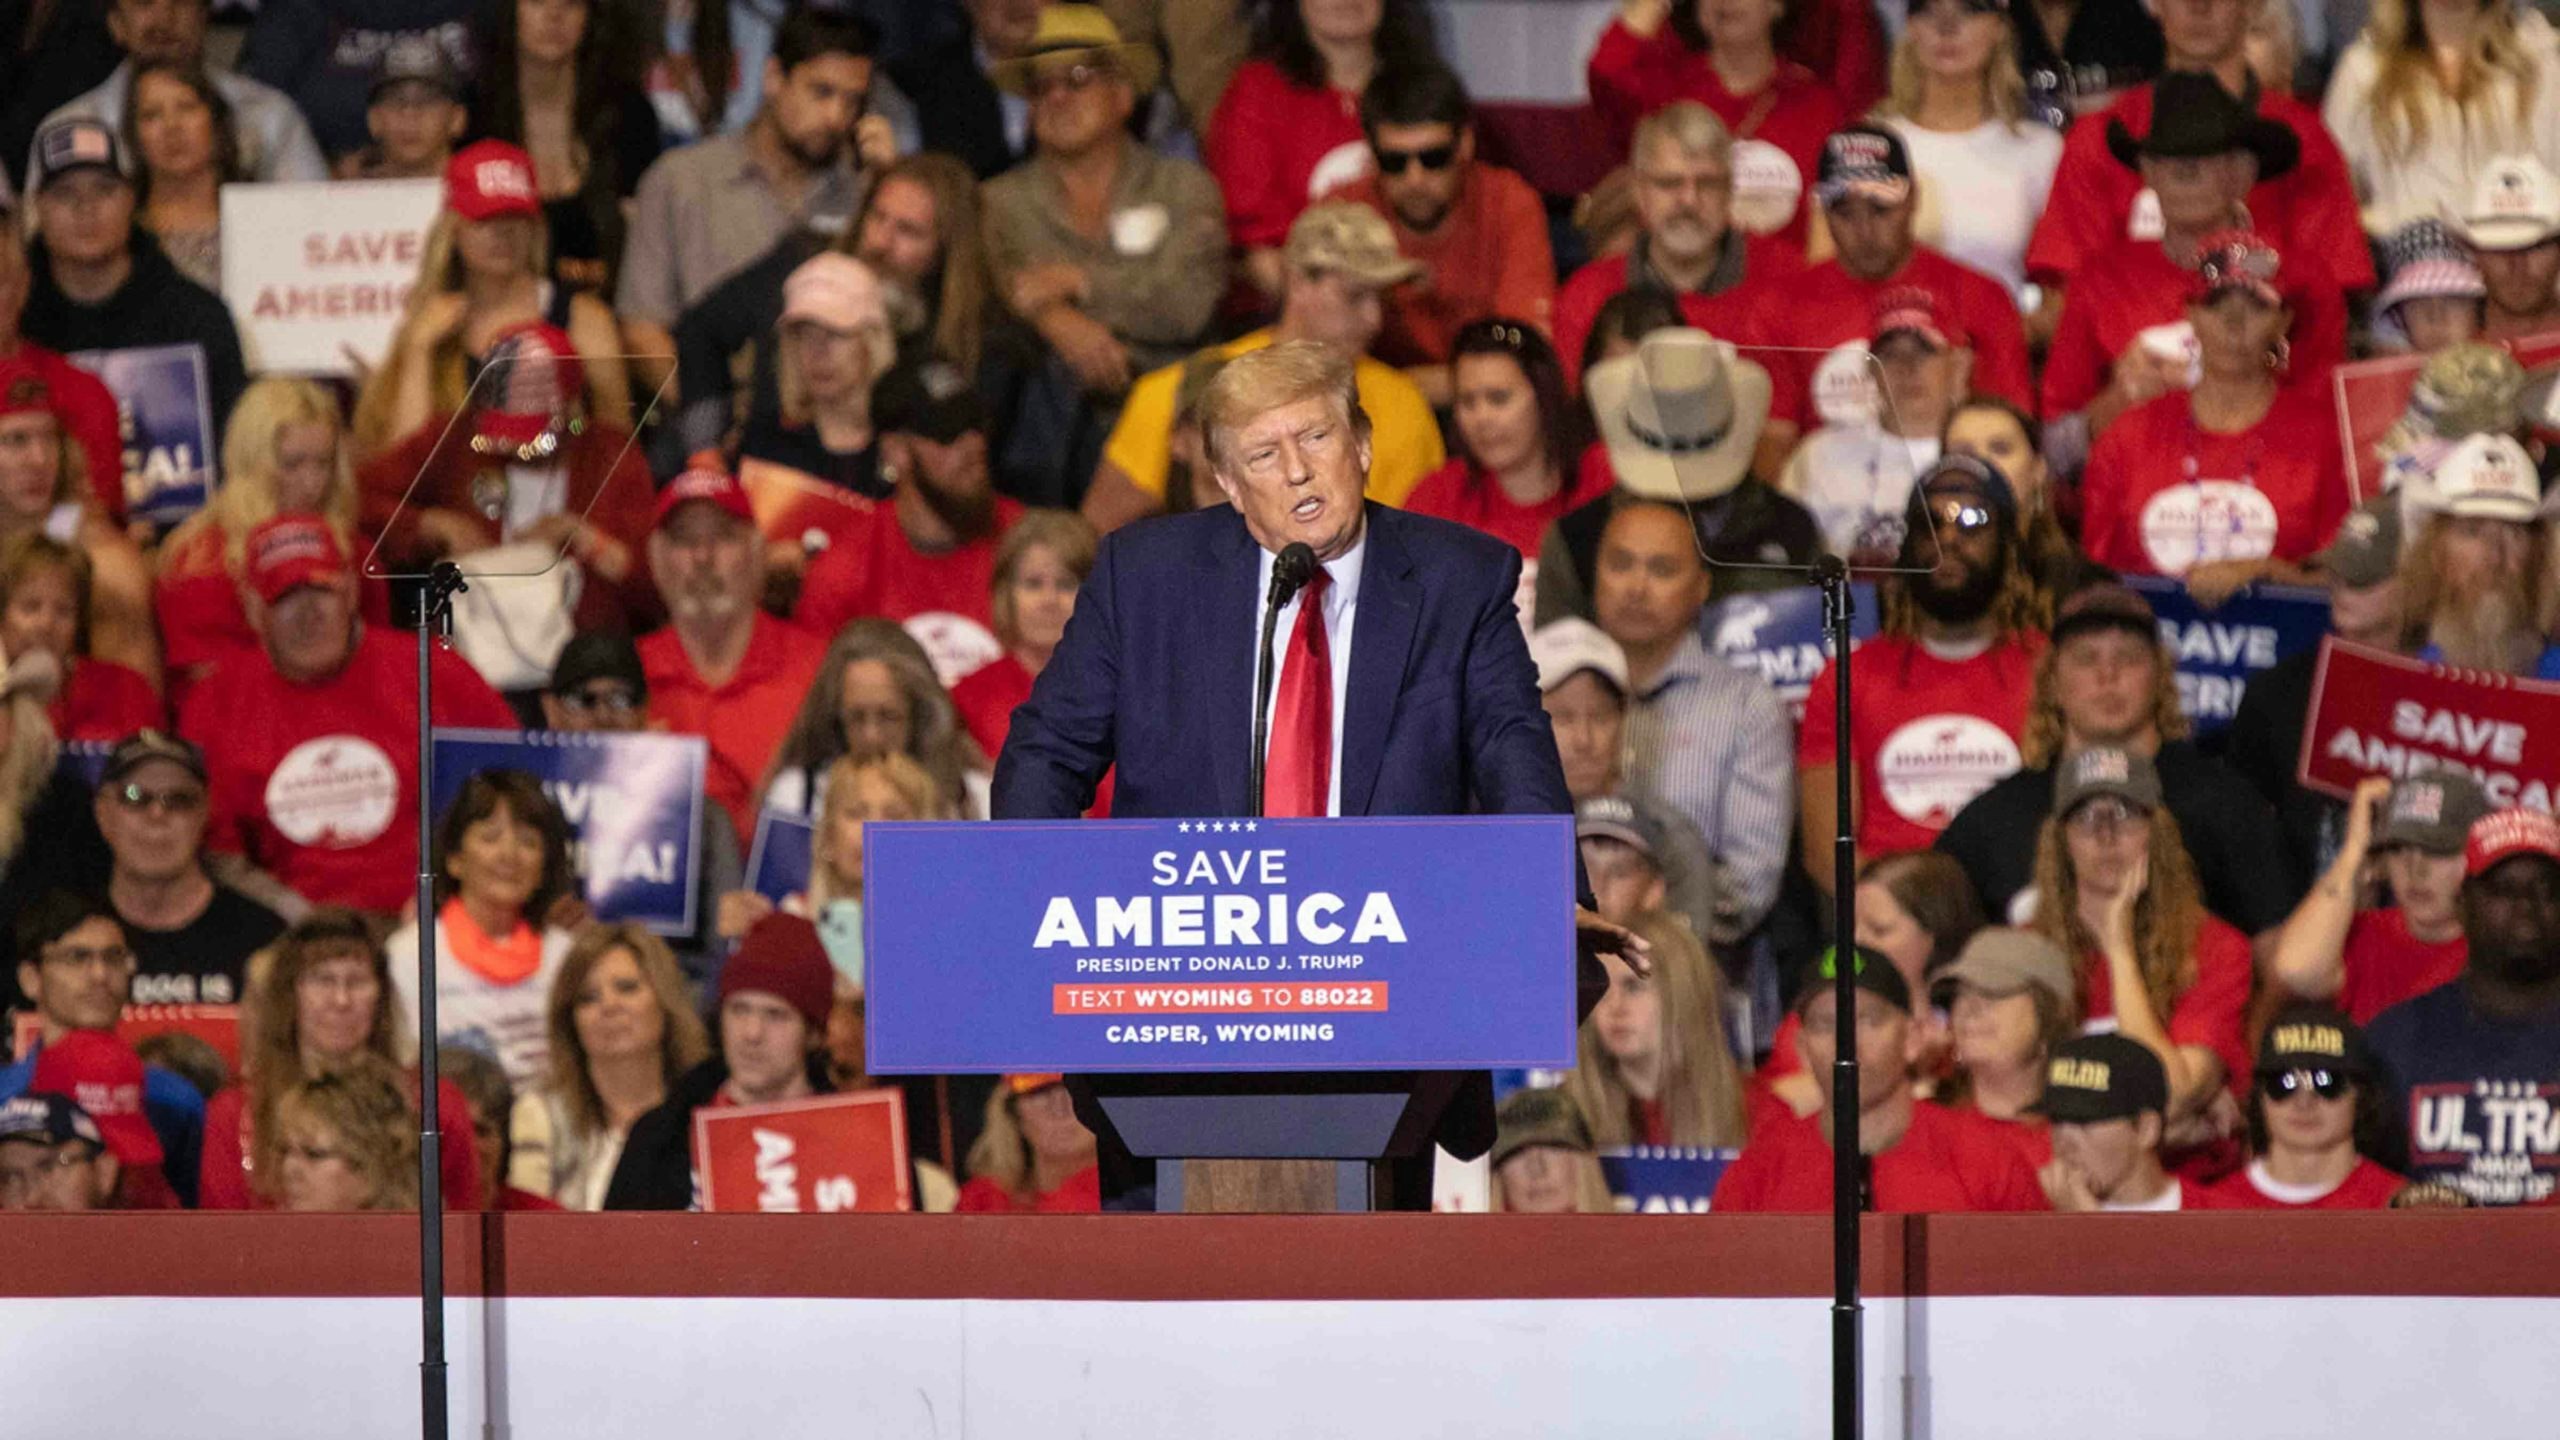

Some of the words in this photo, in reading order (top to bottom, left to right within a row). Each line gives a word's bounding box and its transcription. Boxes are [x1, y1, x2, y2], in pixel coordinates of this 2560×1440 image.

[303, 231, 417, 267] SAVE
[2393, 699, 2527, 765] SAVE
[1152, 849, 1287, 886] SAVE
[1032, 891, 1408, 949] AMERICA
[1076, 957, 1182, 973] PRESIDENT
[1189, 956, 1270, 972] DONALD
[1276, 955, 1293, 971] J.
[1298, 954, 1364, 970] TRUMP
[1067, 989, 1126, 1008] TEXT
[1134, 988, 1253, 1007] WYOMING
[1260, 988, 1292, 1006] TO
[1300, 986, 1374, 1006] 88022
[1106, 1025, 1208, 1046] CASPER,
[1215, 1023, 1335, 1042] WYOMING
